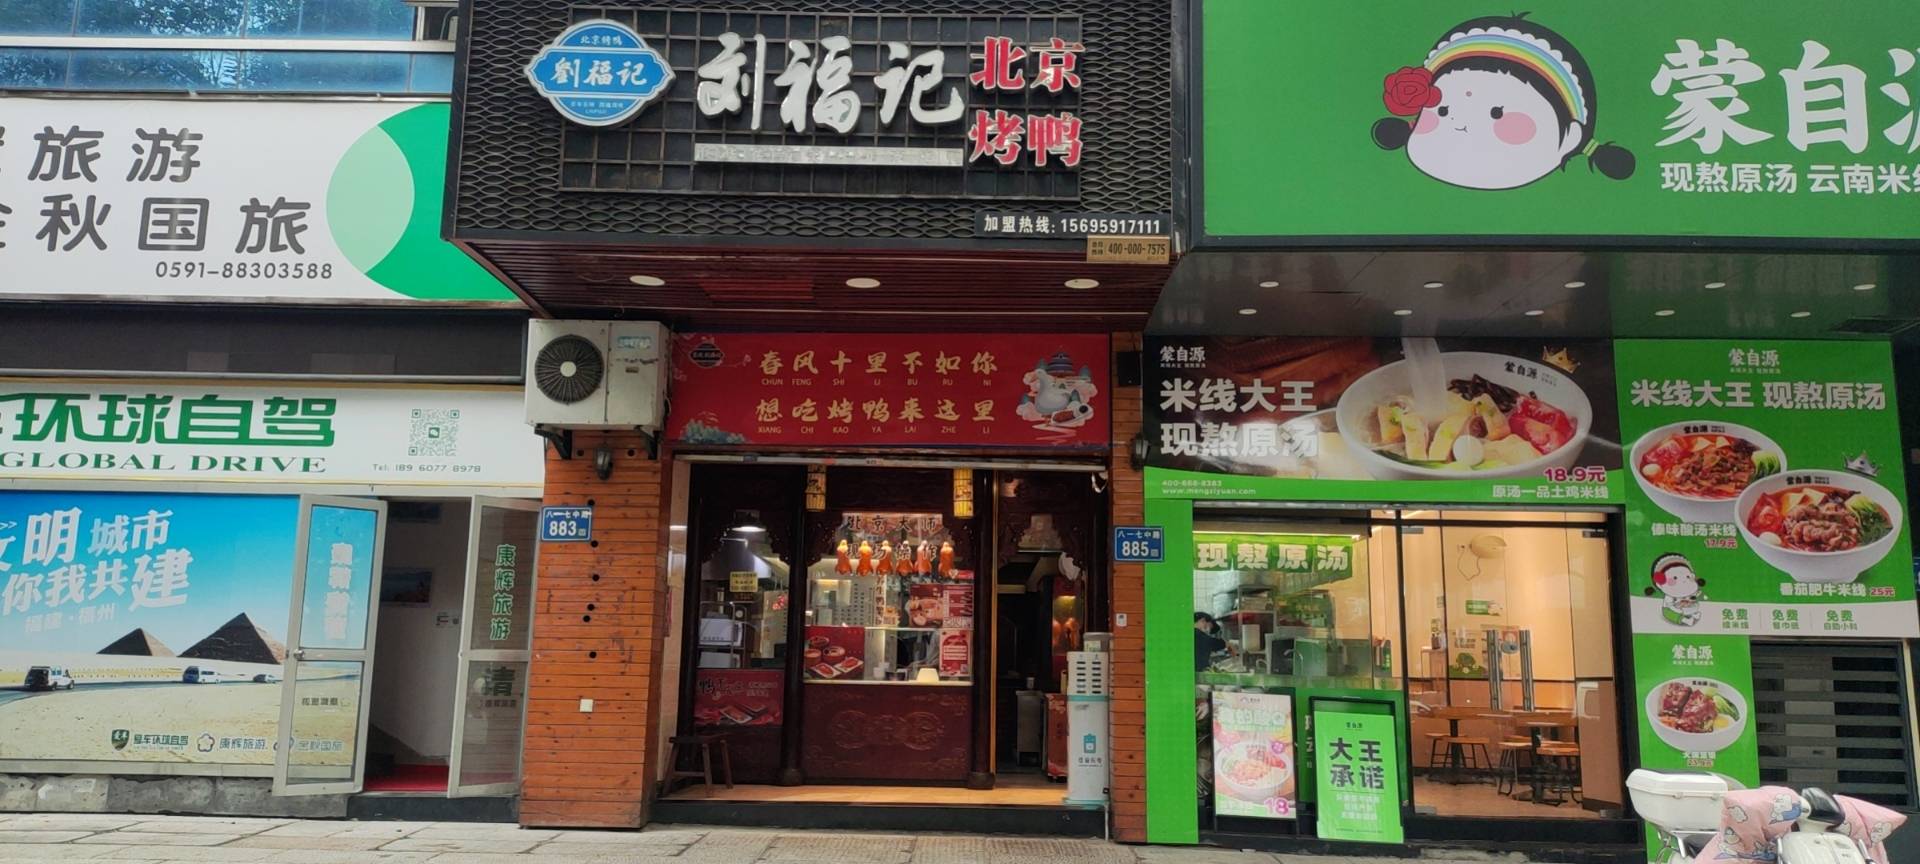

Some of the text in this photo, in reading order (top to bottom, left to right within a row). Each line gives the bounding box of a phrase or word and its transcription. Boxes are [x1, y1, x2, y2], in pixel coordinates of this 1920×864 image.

[970, 36, 1084, 94] 北京
[696, 31, 965, 134] 刘福记
[969, 110, 1083, 167] 烤鸭
[0, 125, 204, 183] 旅游
[1661, 162, 1797, 195] 现熬原汤
[0, 193, 312, 254] 秋国旅
[1060, 219, 1160, 234] 15695917111
[155, 261, 334, 280] 0591-88303588
[759, 350, 998, 375] 春风十里不如你
[1160, 346, 1206, 362] 蒙自源
[1728, 348, 1780, 367] 蒙自源
[761, 378, 784, 386] CHUN
[792, 378, 812, 386] FENG
[832, 378, 845, 386] SHI
[874, 378, 881, 386] LI
[907, 378, 918, 386] BU
[942, 378, 953, 386] RU
[1631, 379, 1886, 411] 米线大王 现熬原汤
[1160, 378, 1317, 413] 米线大王
[0, 393, 337, 447] 环球自驾
[755, 397, 996, 423] 想吃烤鸭来这里
[757, 426, 782, 434] XIANG
[800, 426, 814, 434] CHI
[832, 426, 849, 434] KAO
[871, 426, 882, 434] YA
[941, 426, 957, 434] ZHE
[1160, 422, 1319, 457] 现熬原汤
[0, 452, 327, 473] GLOBAL DRIVE
[418, 464, 448, 472] 6077
[1544, 466, 1607, 484] 18.9元
[1492, 485, 1609, 499] 原汤一品土鸡米线
[549, 521, 577, 536] 883
[1122, 541, 1149, 556] 885
[1197, 542, 1349, 571] 现熬原汤
[2, 548, 194, 616] 你我共建
[490, 543, 516, 640] 康辉旅游
[1329, 737, 1382, 763] 大王
[1330, 764, 1385, 790] 承诺
